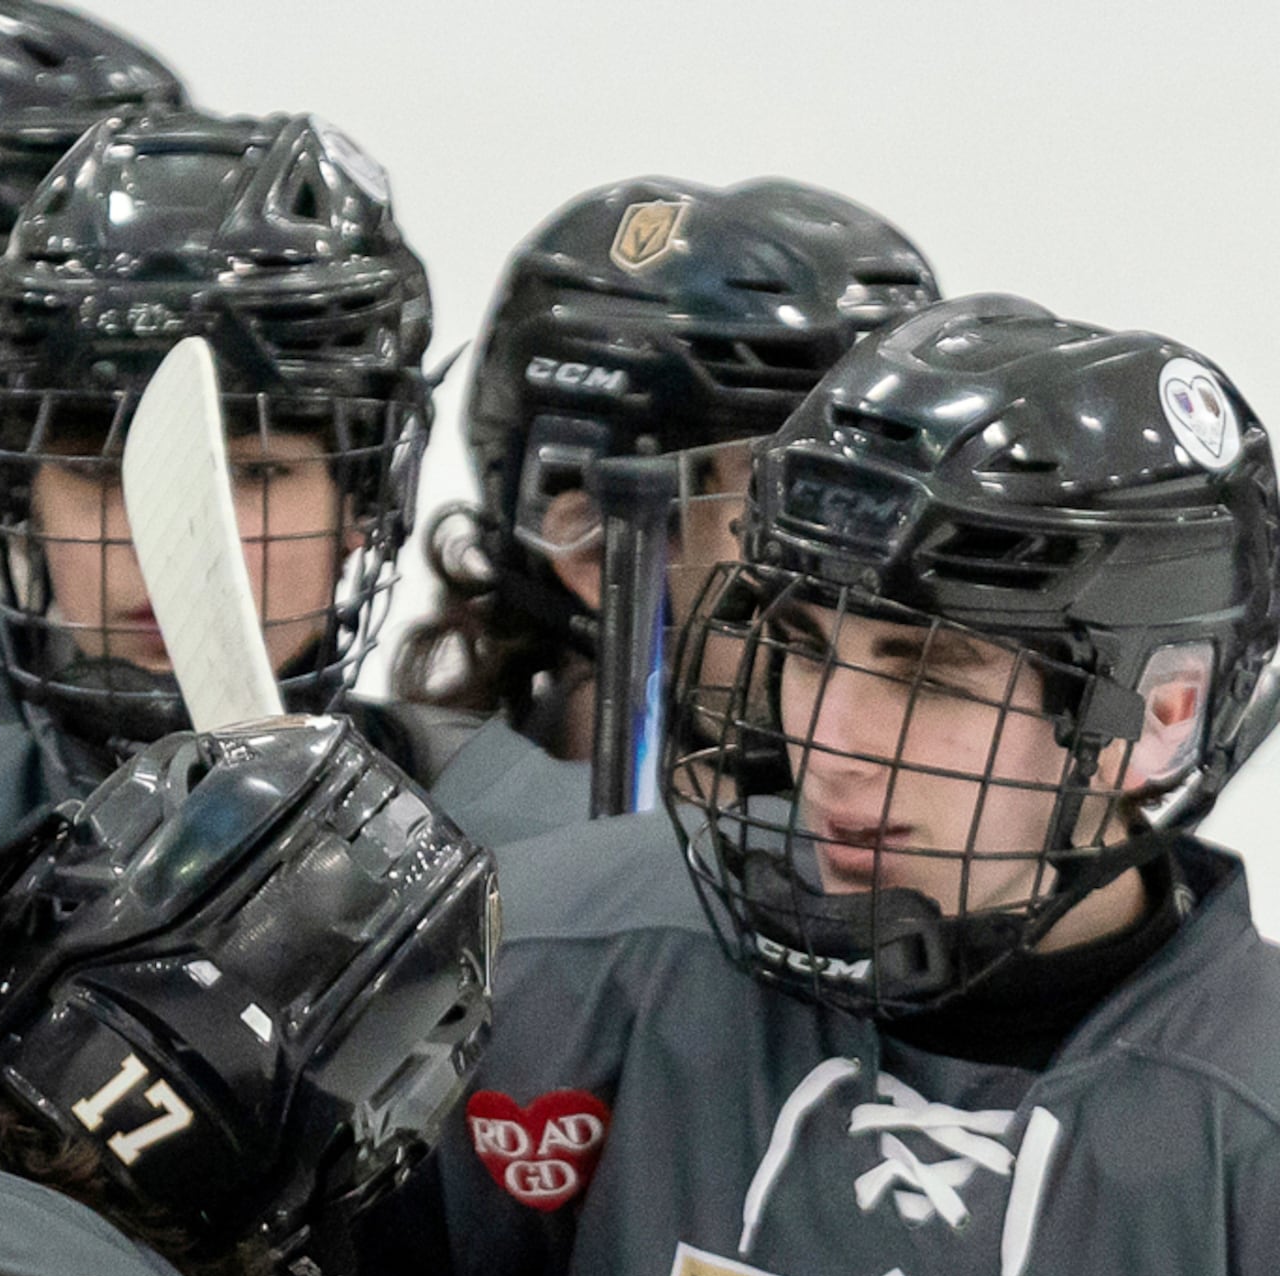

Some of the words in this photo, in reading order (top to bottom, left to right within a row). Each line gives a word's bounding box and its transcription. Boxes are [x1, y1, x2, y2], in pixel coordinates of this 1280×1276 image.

[525, 357, 626, 390] CCM
[71, 1053, 195, 1167] 17
[505, 1160, 577, 1197] GD
